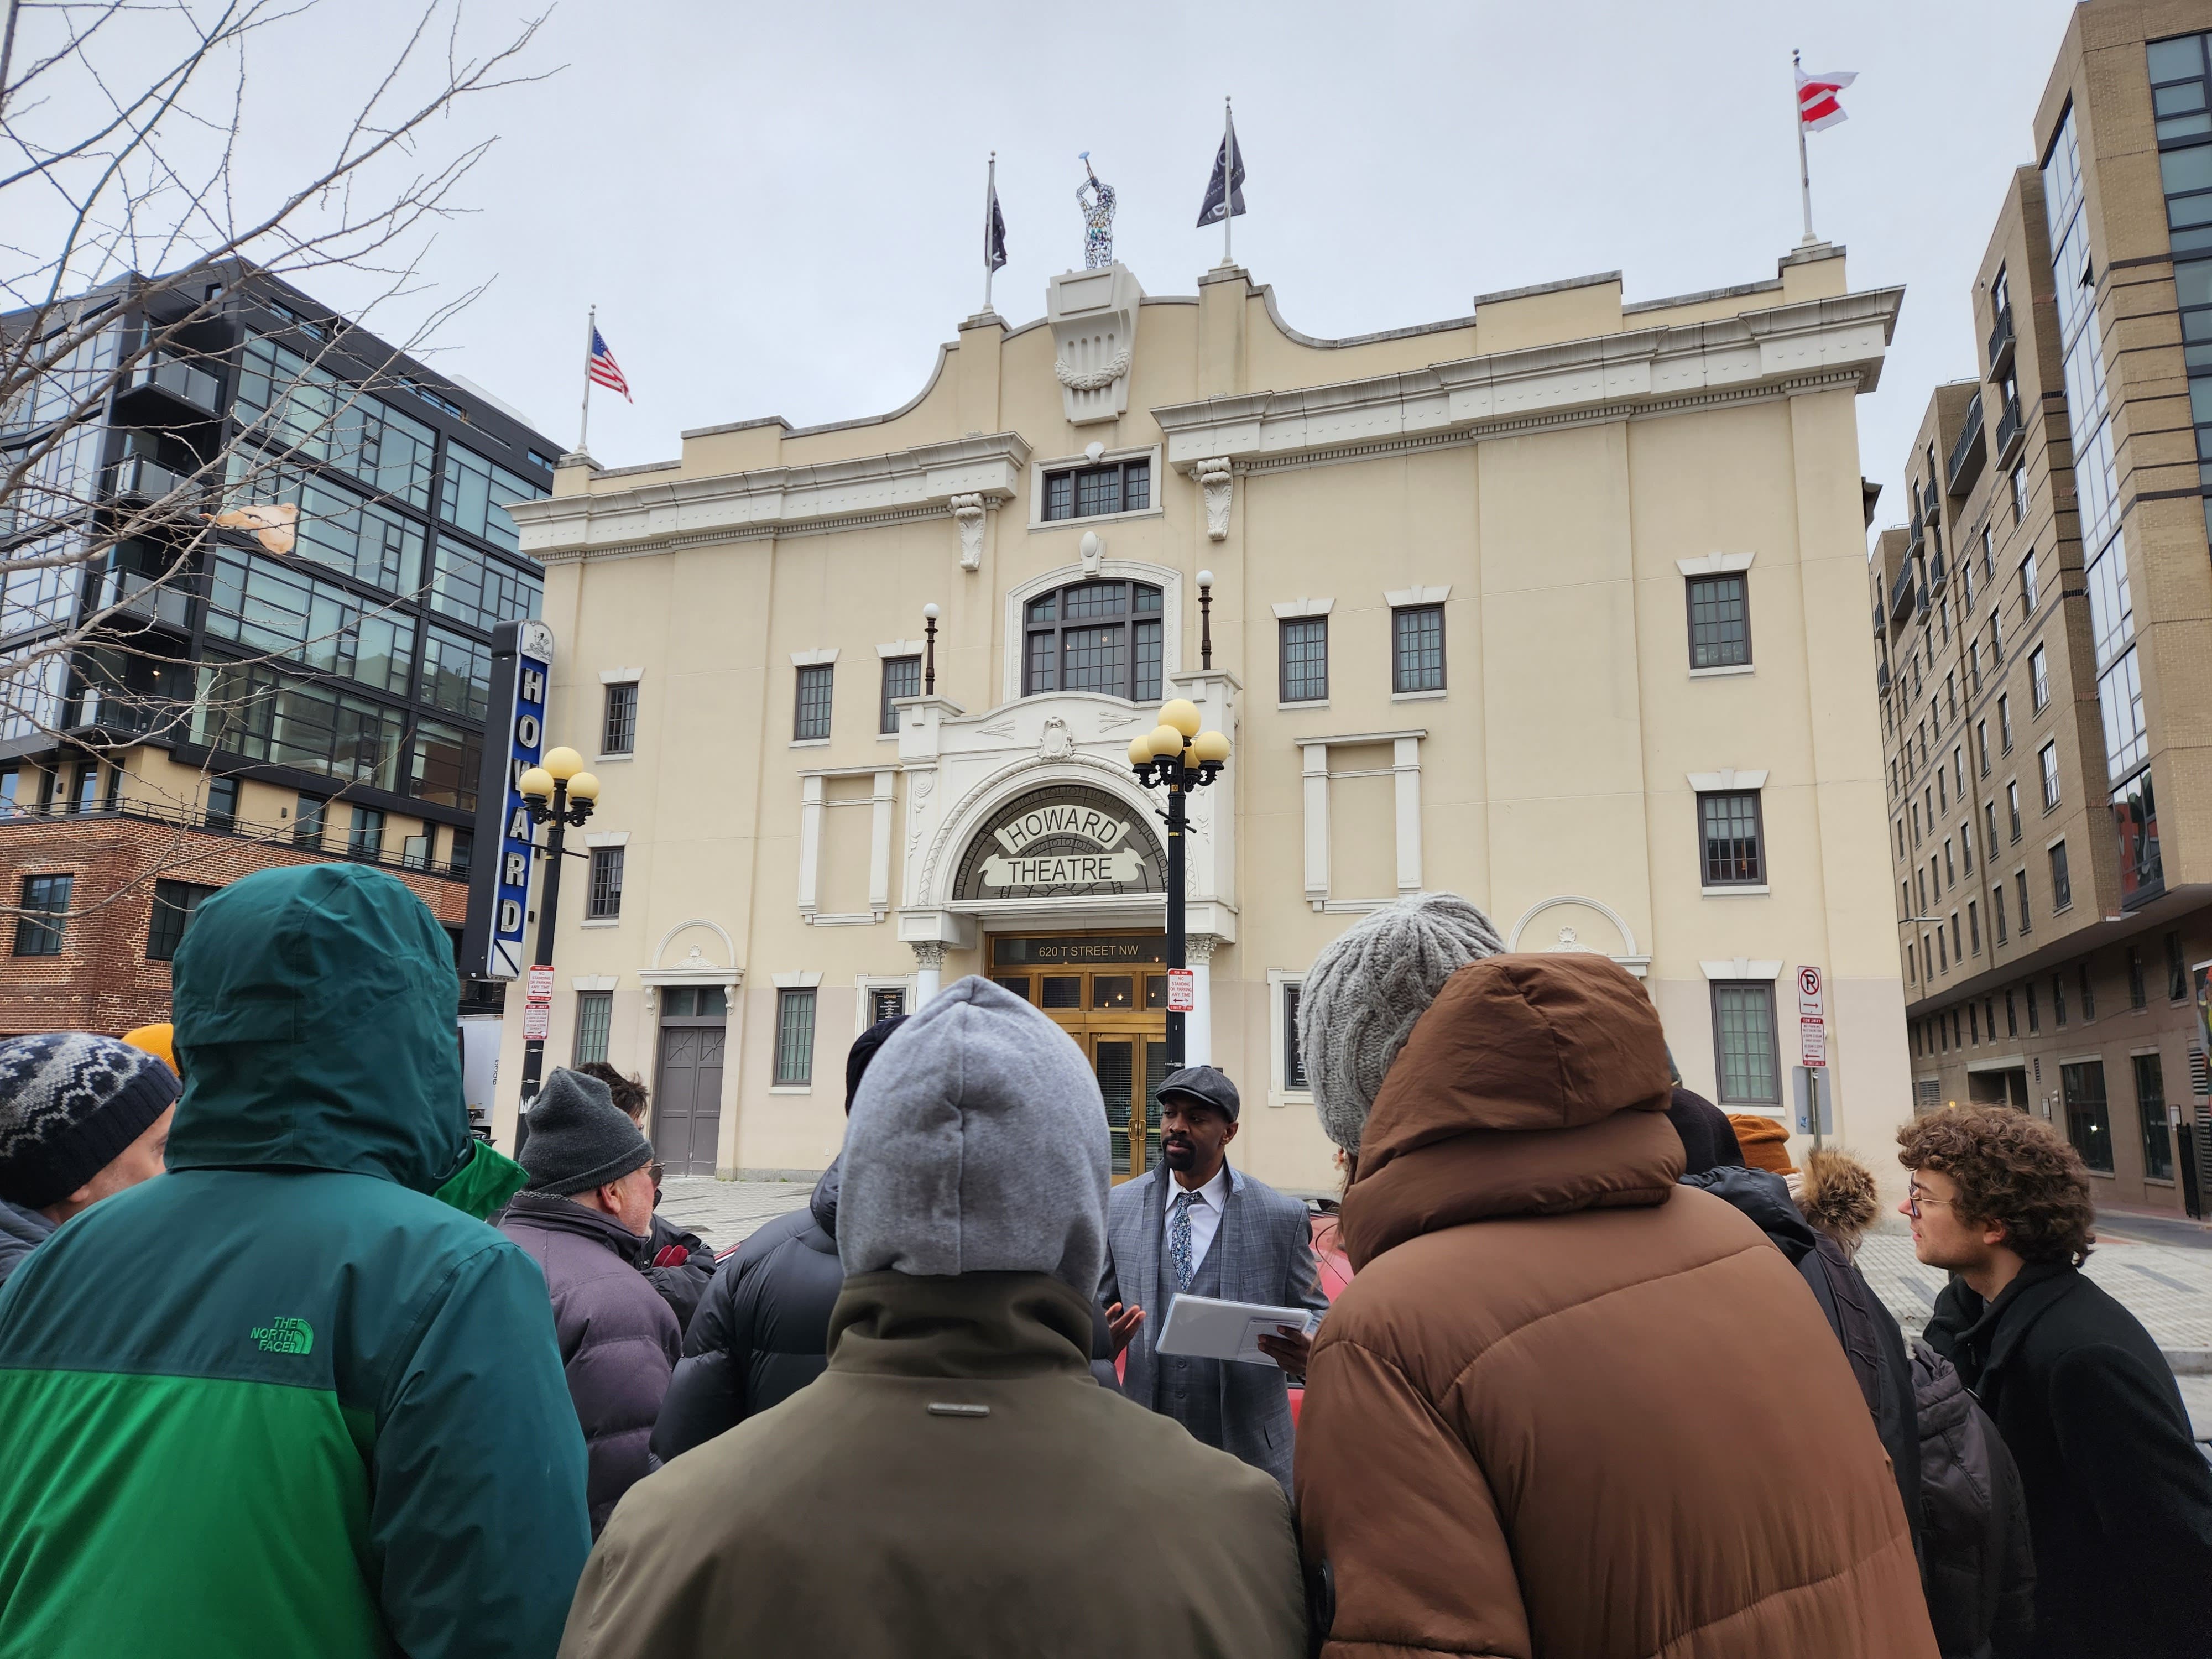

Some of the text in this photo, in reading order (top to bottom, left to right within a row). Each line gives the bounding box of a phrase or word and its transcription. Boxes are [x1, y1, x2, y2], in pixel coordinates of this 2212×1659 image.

[1005, 807, 1118, 849] HOWARD
[1008, 857, 1112, 883] THEATRE
[1039, 945, 1139, 957] 620 T STREET NW
[274, 1317, 298, 1329] THE
[250, 1327, 295, 1342] NORTH
[258, 1339, 291, 1353] FACE
